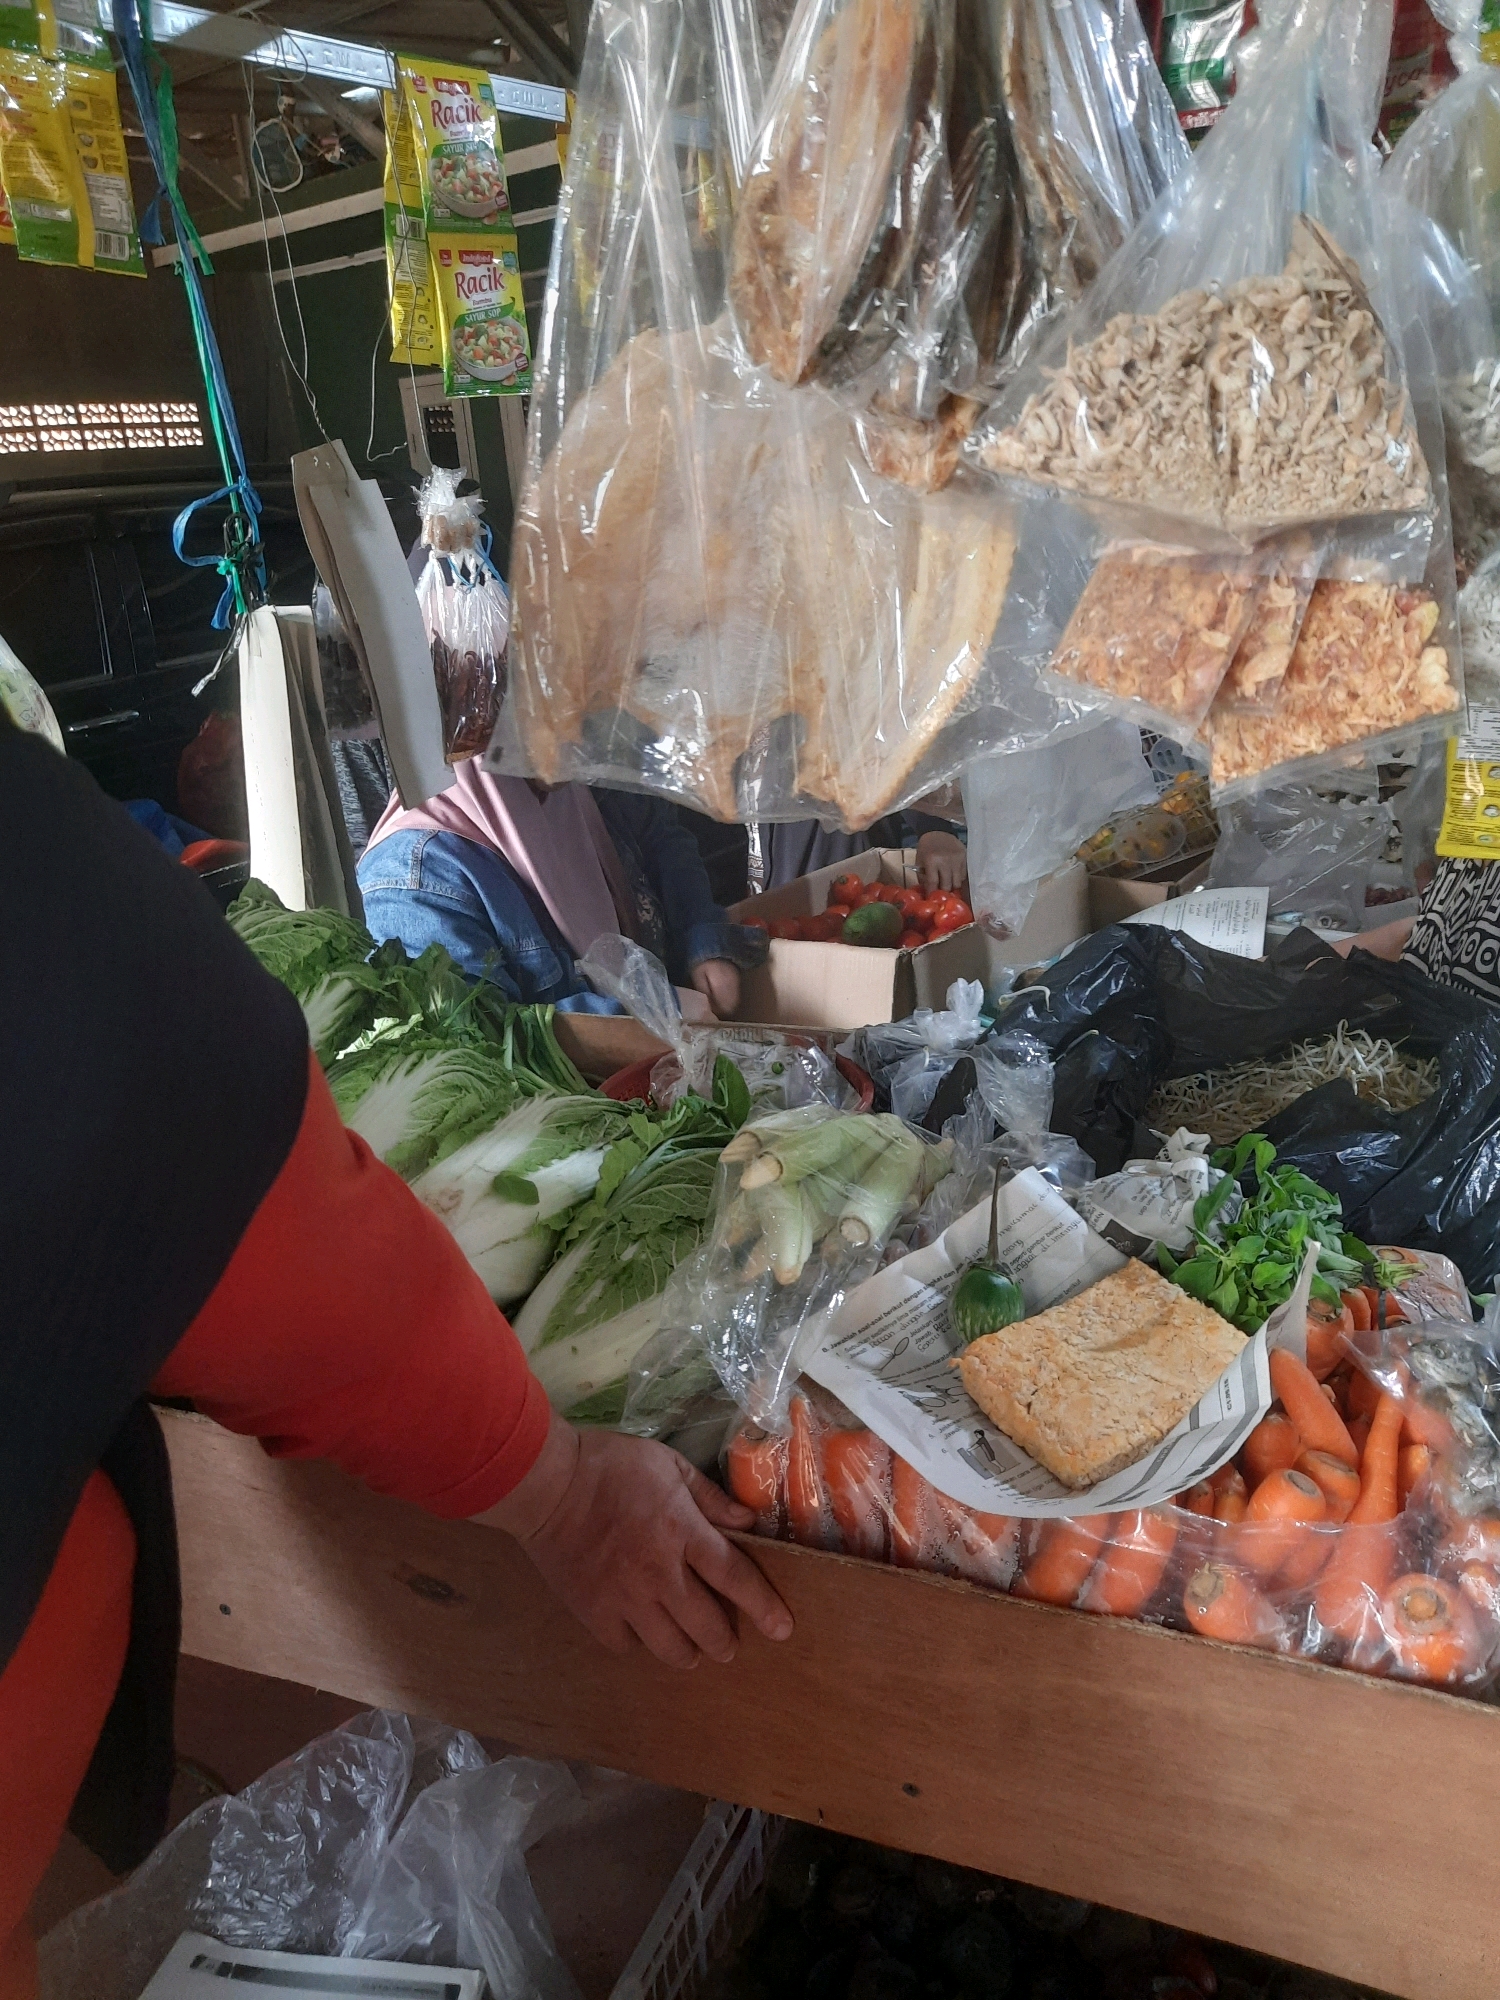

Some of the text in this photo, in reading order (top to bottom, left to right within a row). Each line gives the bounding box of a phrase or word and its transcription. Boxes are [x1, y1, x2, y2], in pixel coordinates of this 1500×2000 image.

[430, 97, 482, 130] Racik
[442, 142, 465, 156] SAYUR
[454, 266, 506, 300] Racik
[464, 307, 502, 324] SAYUR SOP
[830, 1332, 857, 1349] Jawablah
[857, 1314, 884, 1334] soal-soal
[882, 1301, 904, 1317] berikut
[903, 1288, 924, 1304] dengan
[909, 1321, 930, 1338] Jelaskan
